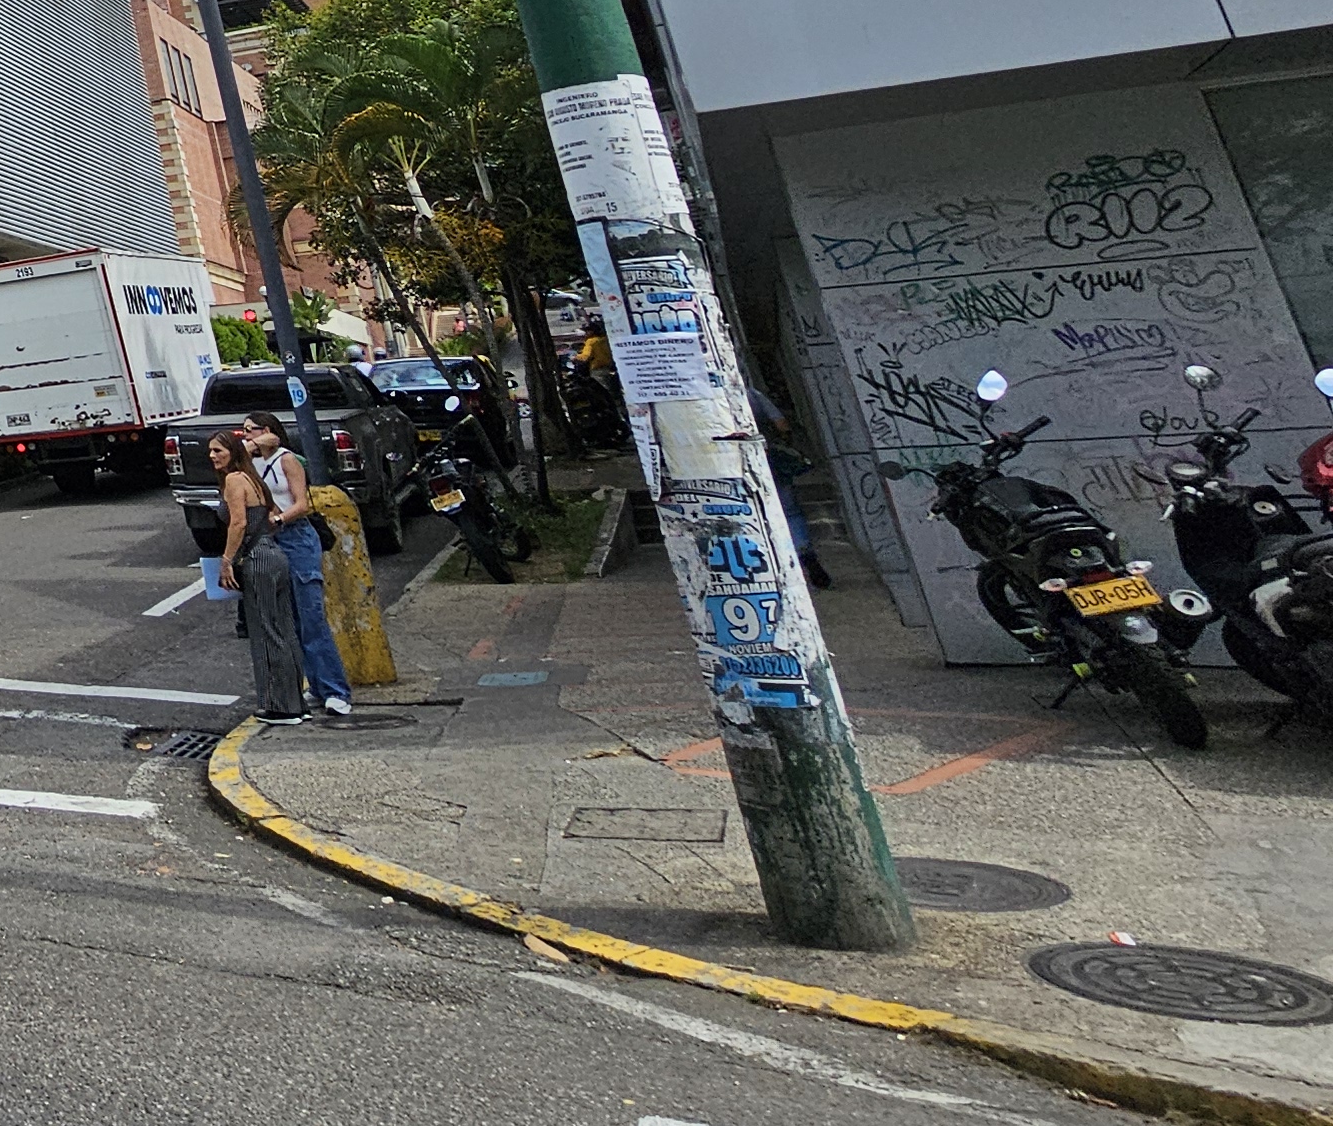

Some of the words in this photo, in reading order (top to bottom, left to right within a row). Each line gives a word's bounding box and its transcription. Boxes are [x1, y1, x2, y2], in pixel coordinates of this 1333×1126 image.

[570, 109, 628, 121] BUCARAMANGA
[292, 389, 304, 403] 19
[703, 504, 753, 515] GRUPO
[723, 597, 760, 642] 9
[760, 600, 777, 622] 7
[728, 642, 773, 655] NOVIEM
